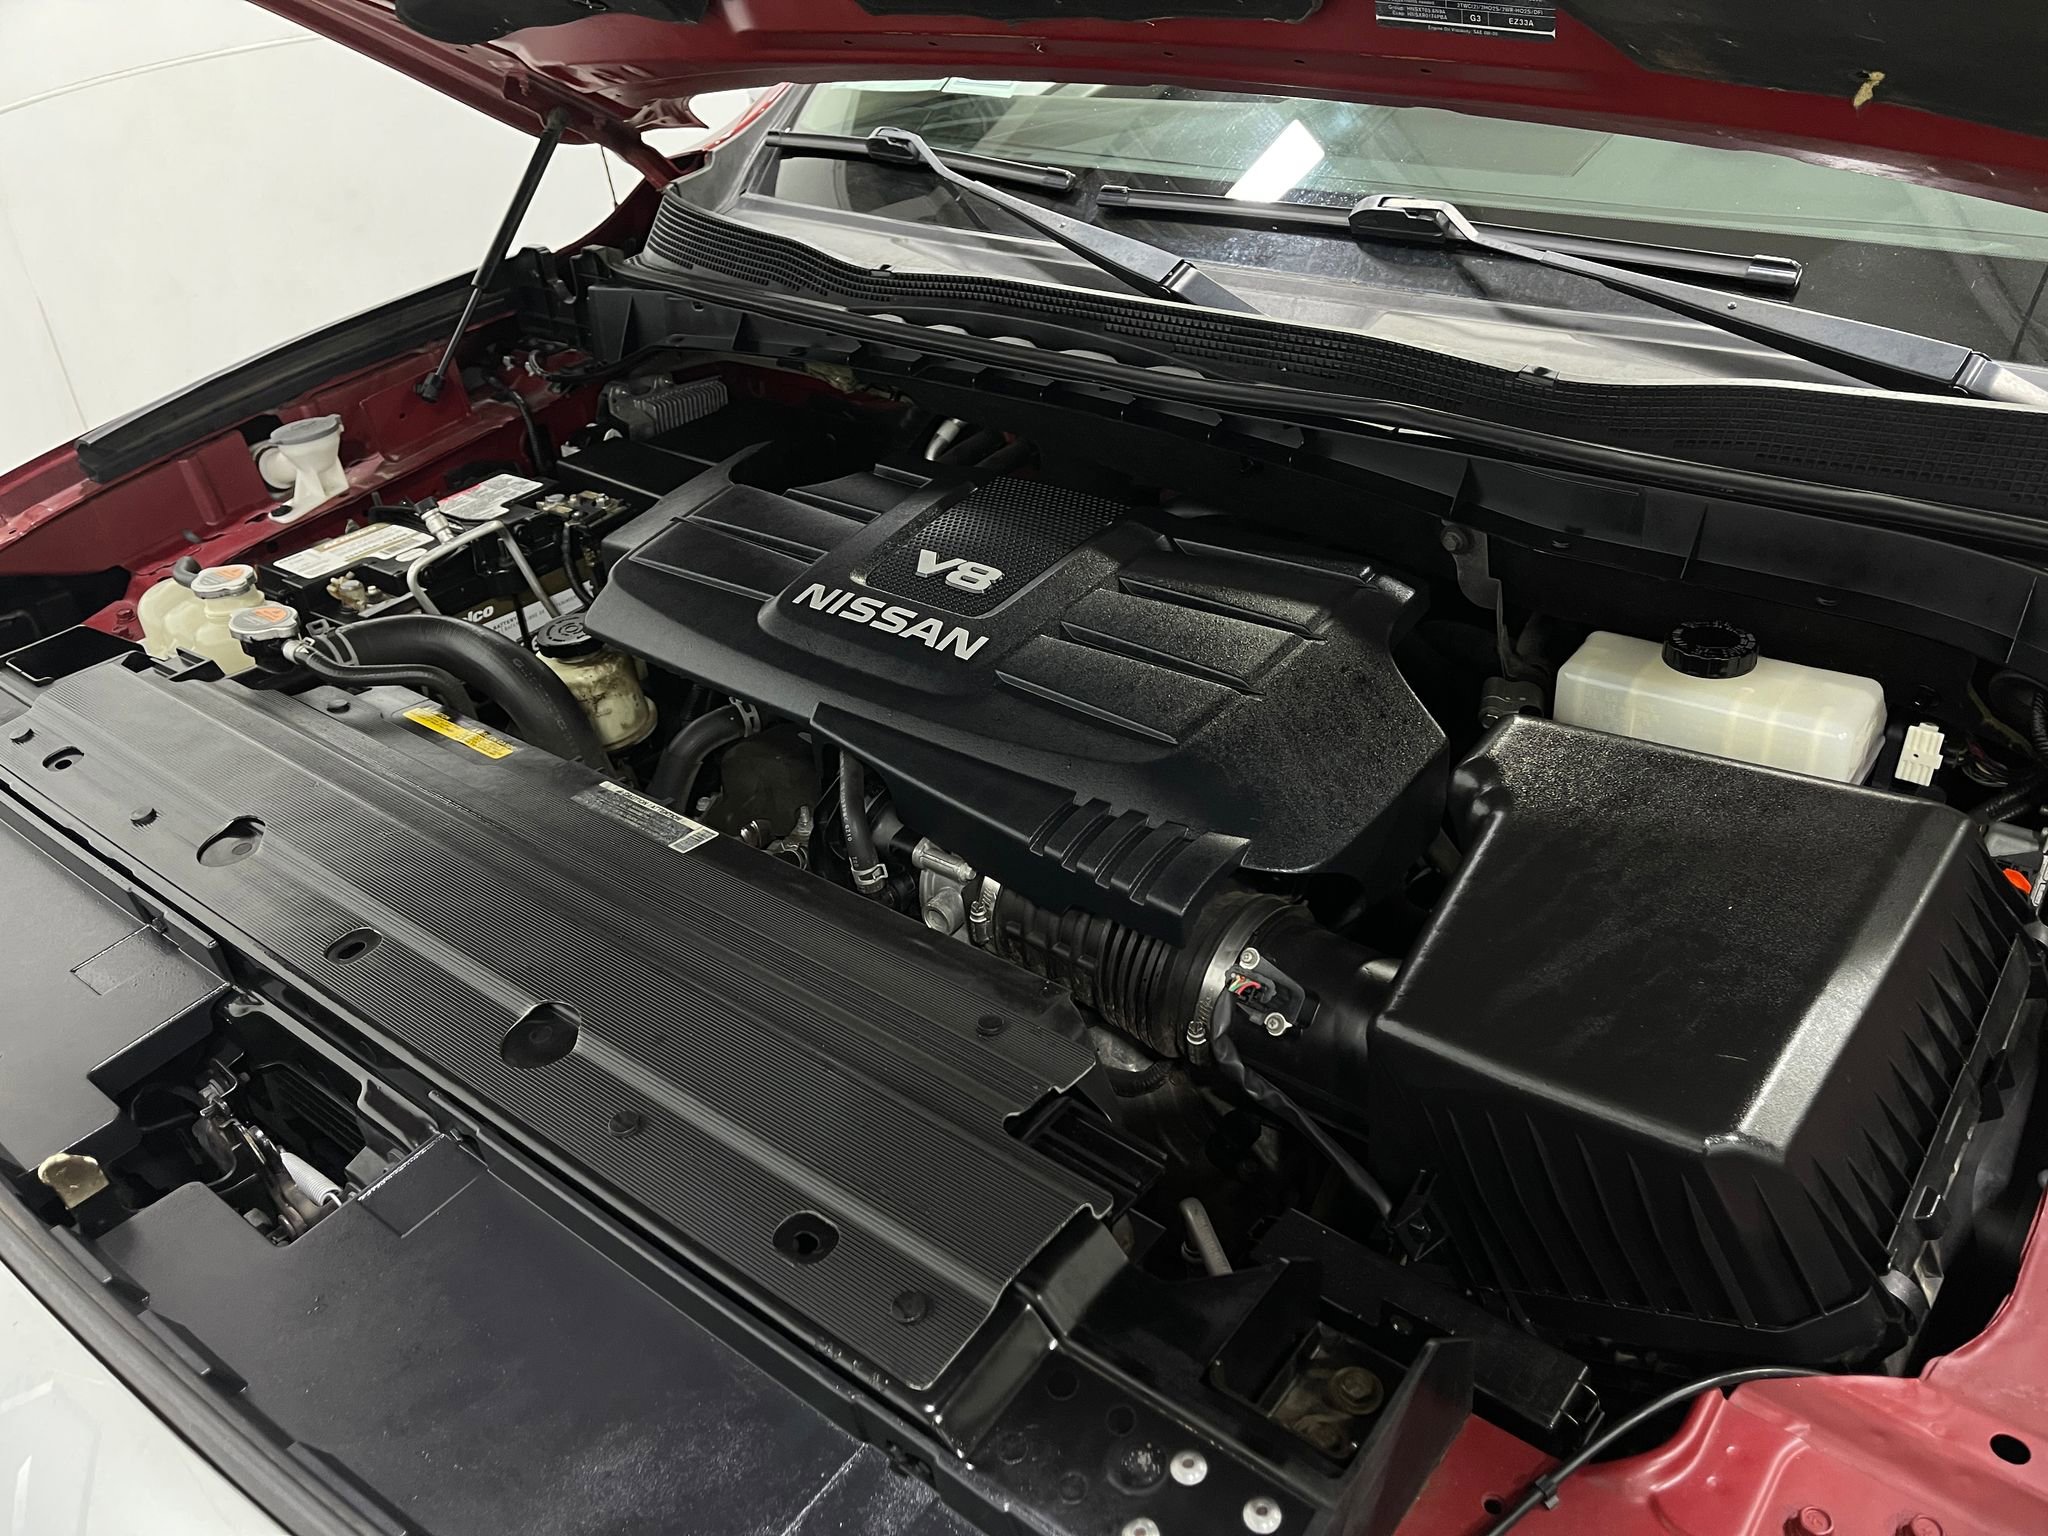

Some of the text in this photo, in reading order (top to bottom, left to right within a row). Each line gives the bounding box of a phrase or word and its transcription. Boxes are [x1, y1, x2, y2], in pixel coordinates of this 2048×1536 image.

[1469, 14, 1481, 22] G3
[1508, 17, 1534, 27] EZ33A
[915, 549, 1004, 593] V8
[792, 583, 989, 660] NISSAN
